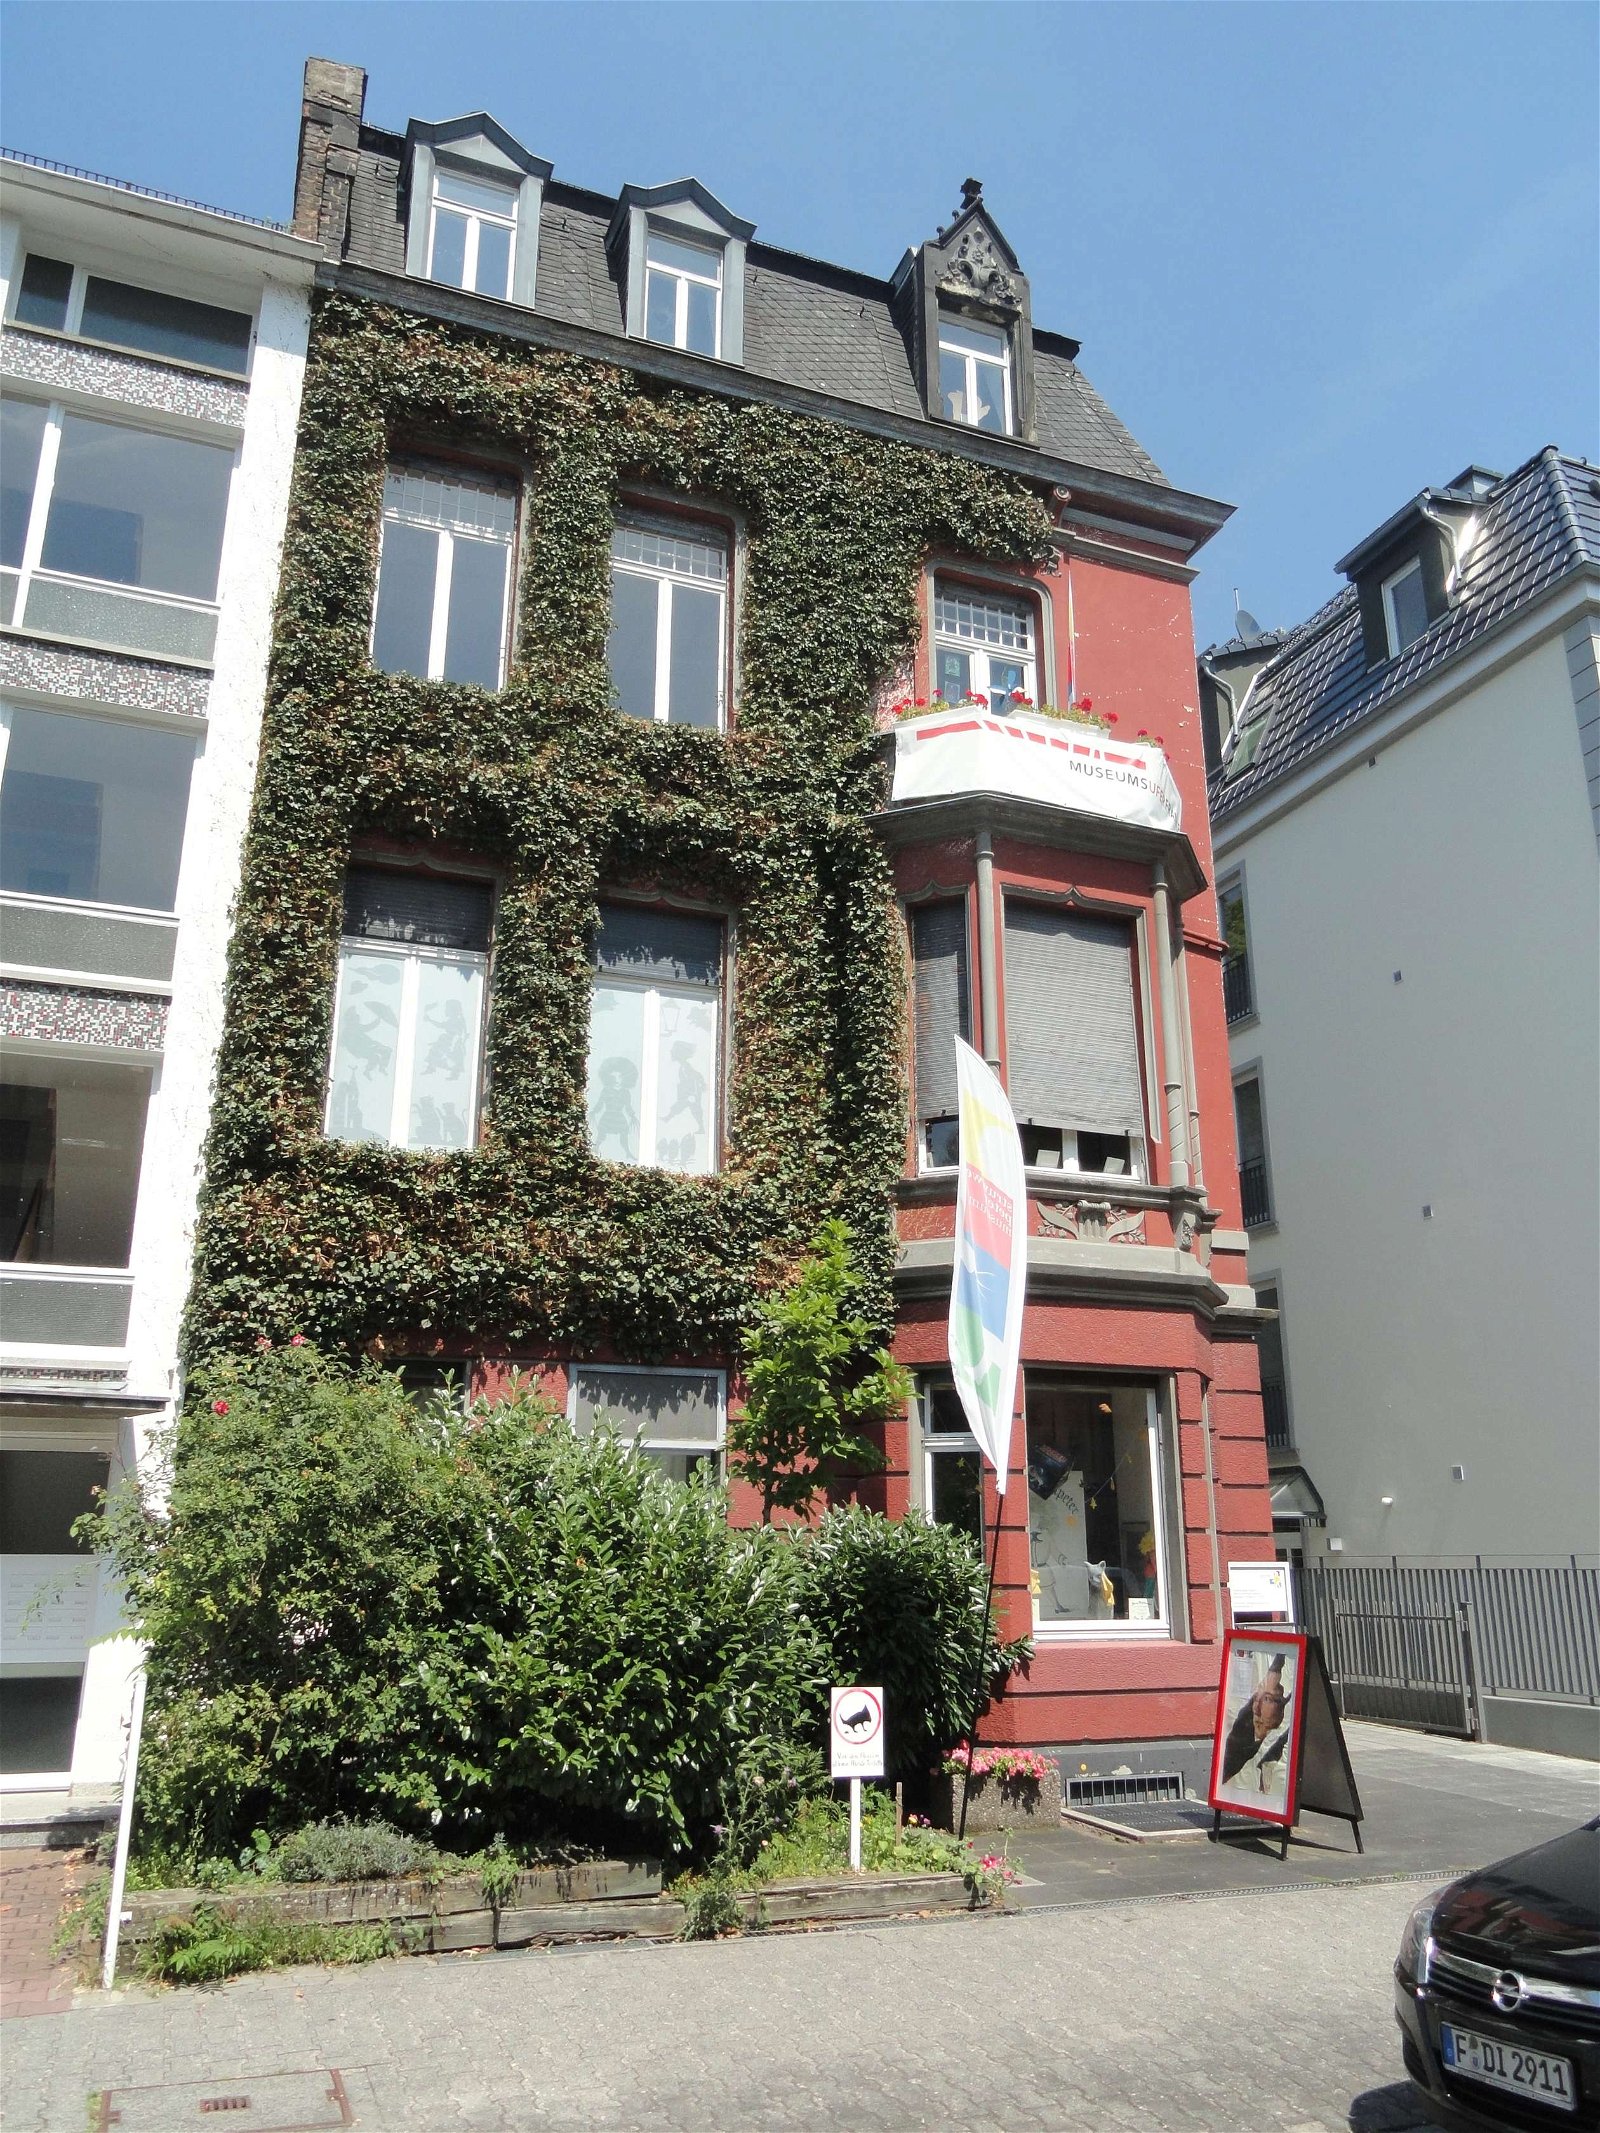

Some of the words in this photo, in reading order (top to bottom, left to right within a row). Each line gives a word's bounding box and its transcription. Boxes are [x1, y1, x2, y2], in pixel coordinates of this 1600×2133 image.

[1455, 2033, 1466, 2062] F
[1480, 2042, 1507, 2077] DI
[1512, 2051, 1568, 2096] 2911
